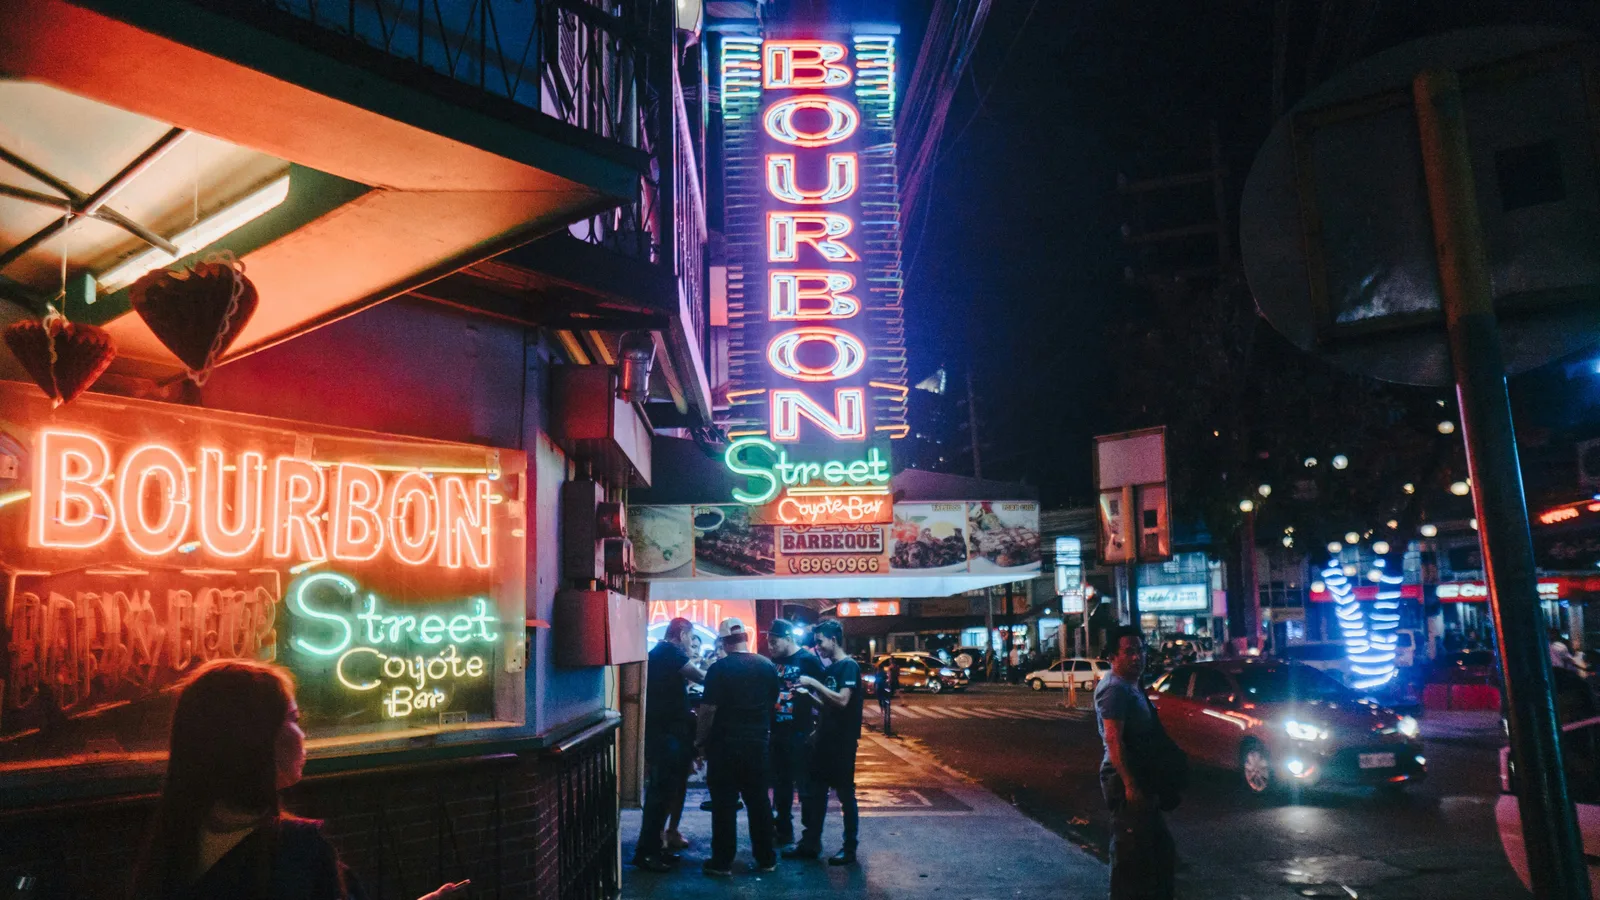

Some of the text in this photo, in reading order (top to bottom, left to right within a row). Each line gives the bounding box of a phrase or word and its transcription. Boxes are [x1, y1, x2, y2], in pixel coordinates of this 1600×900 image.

[762, 40, 867, 441] BOURBON
[725, 436, 891, 505] Street
[34, 429, 494, 569] BOURBON
[777, 495, 884, 523] Coyote Bar
[782, 533, 881, 550] BARBEQUE
[800, 556, 880, 574] 896-0966
[296, 571, 500, 656] Street
[336, 644, 484, 692] Coyote
[382, 686, 446, 719] Bar
